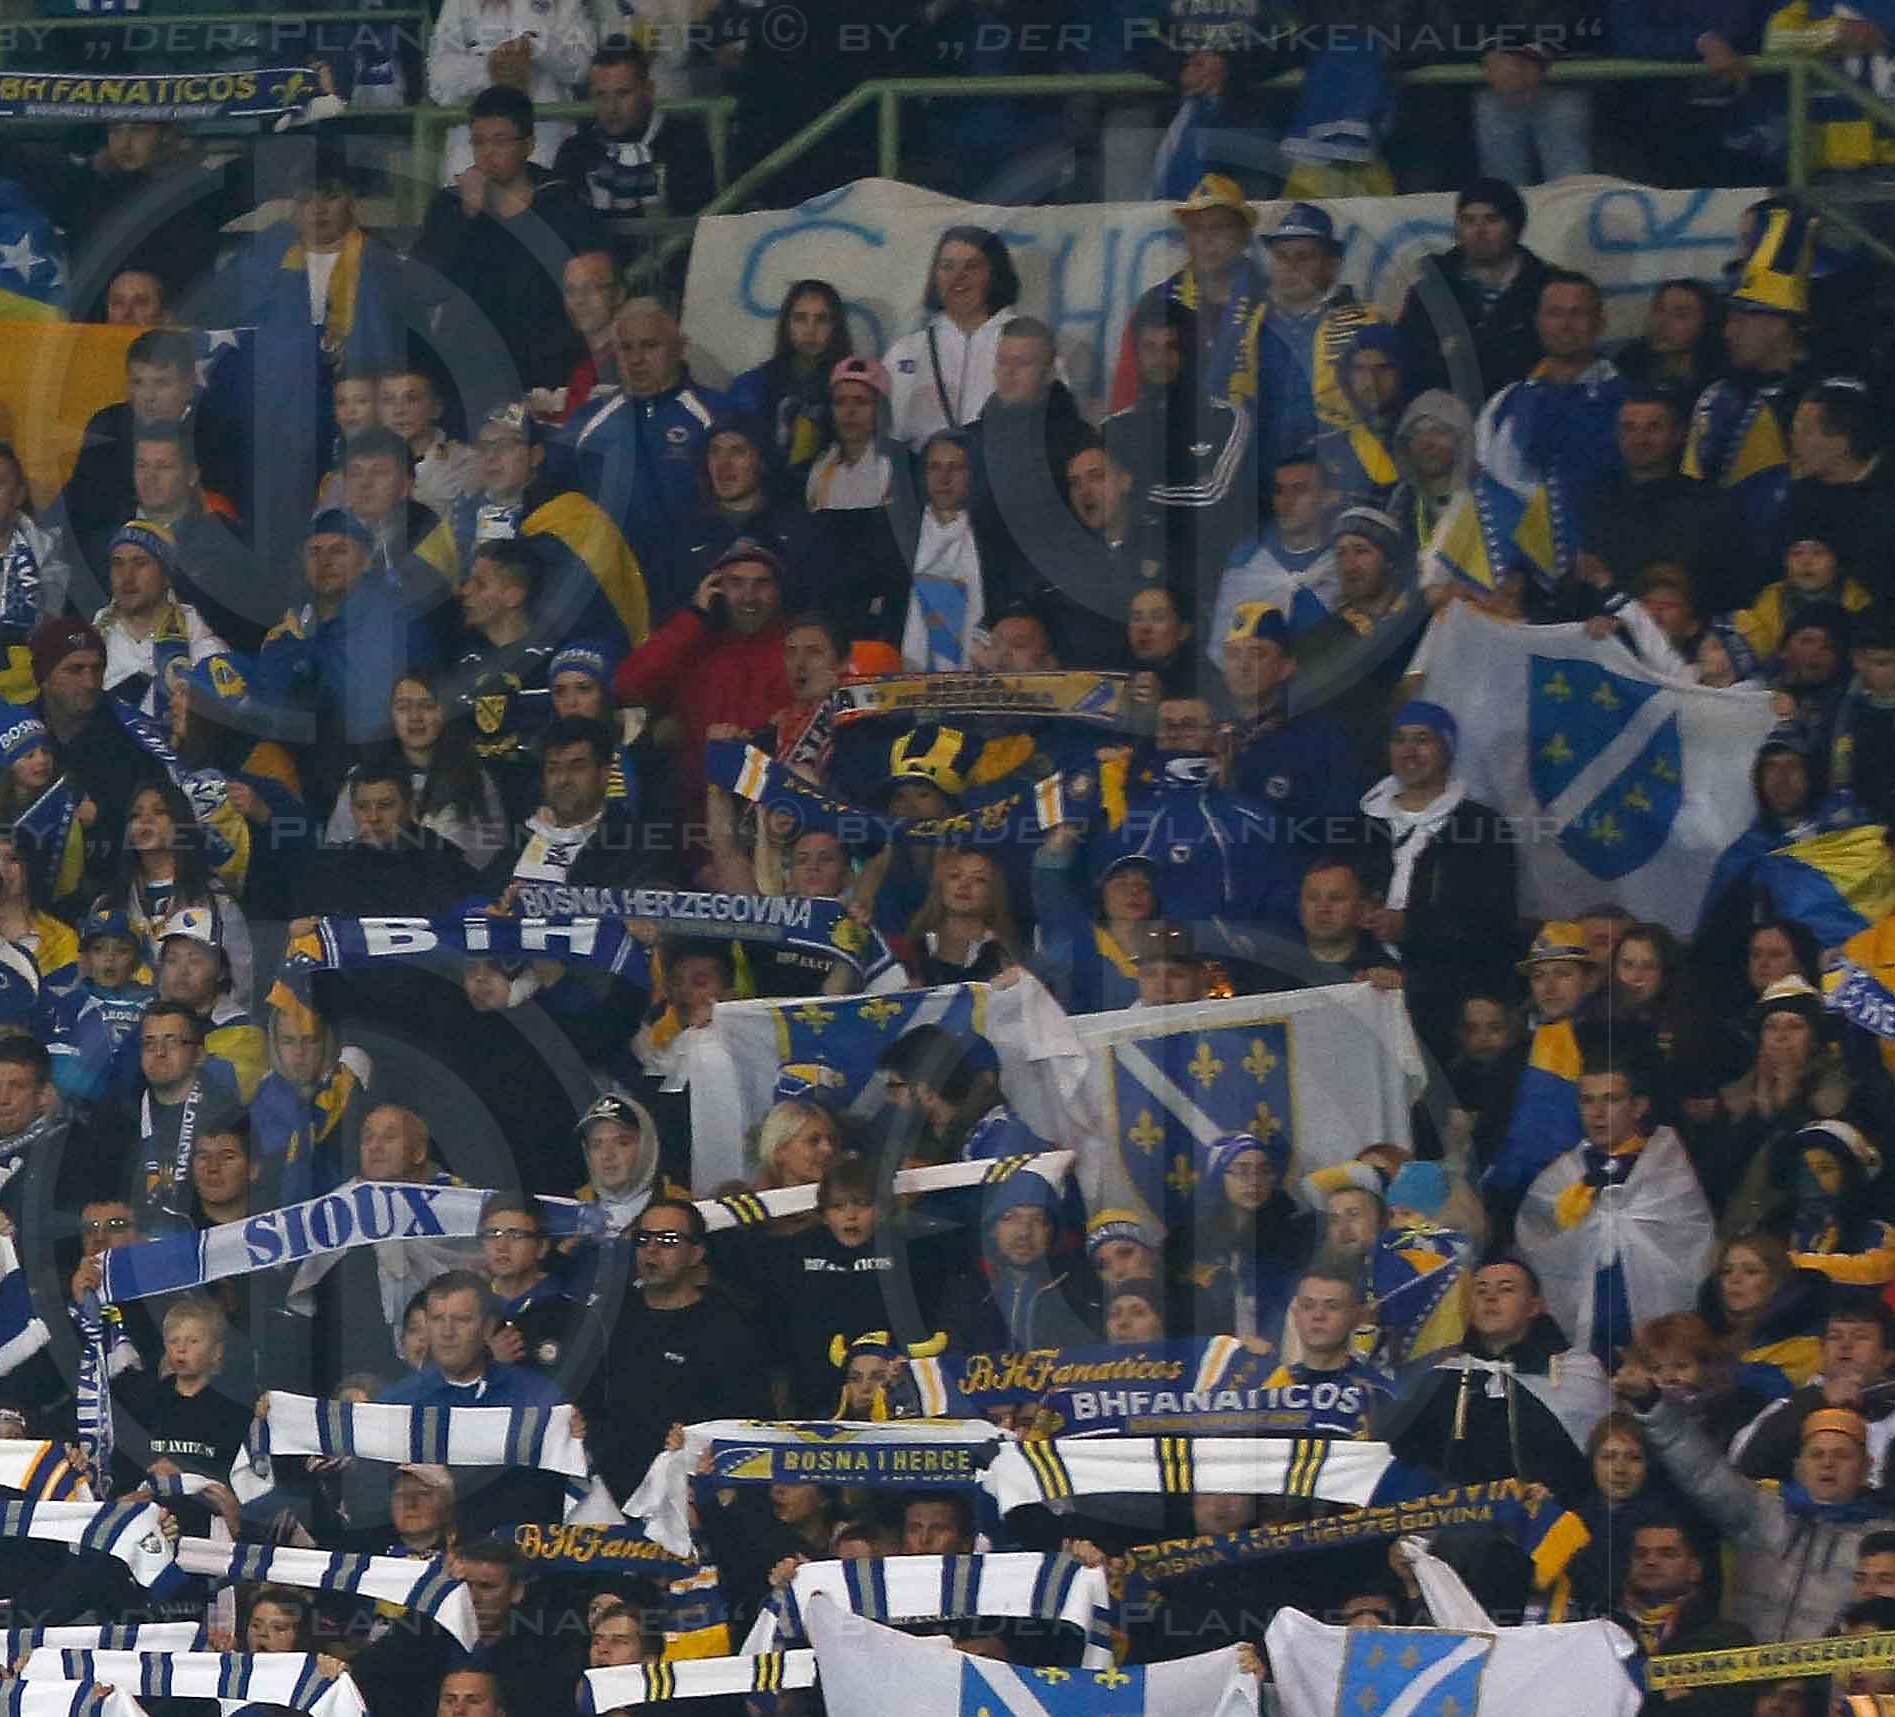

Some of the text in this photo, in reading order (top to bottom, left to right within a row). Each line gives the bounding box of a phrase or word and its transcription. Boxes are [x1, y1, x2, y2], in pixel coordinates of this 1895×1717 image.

[51, 73, 258, 106] FANATICOS
[358, 917, 601, 956] BiH
[241, 1184, 447, 1267] SIOUX
